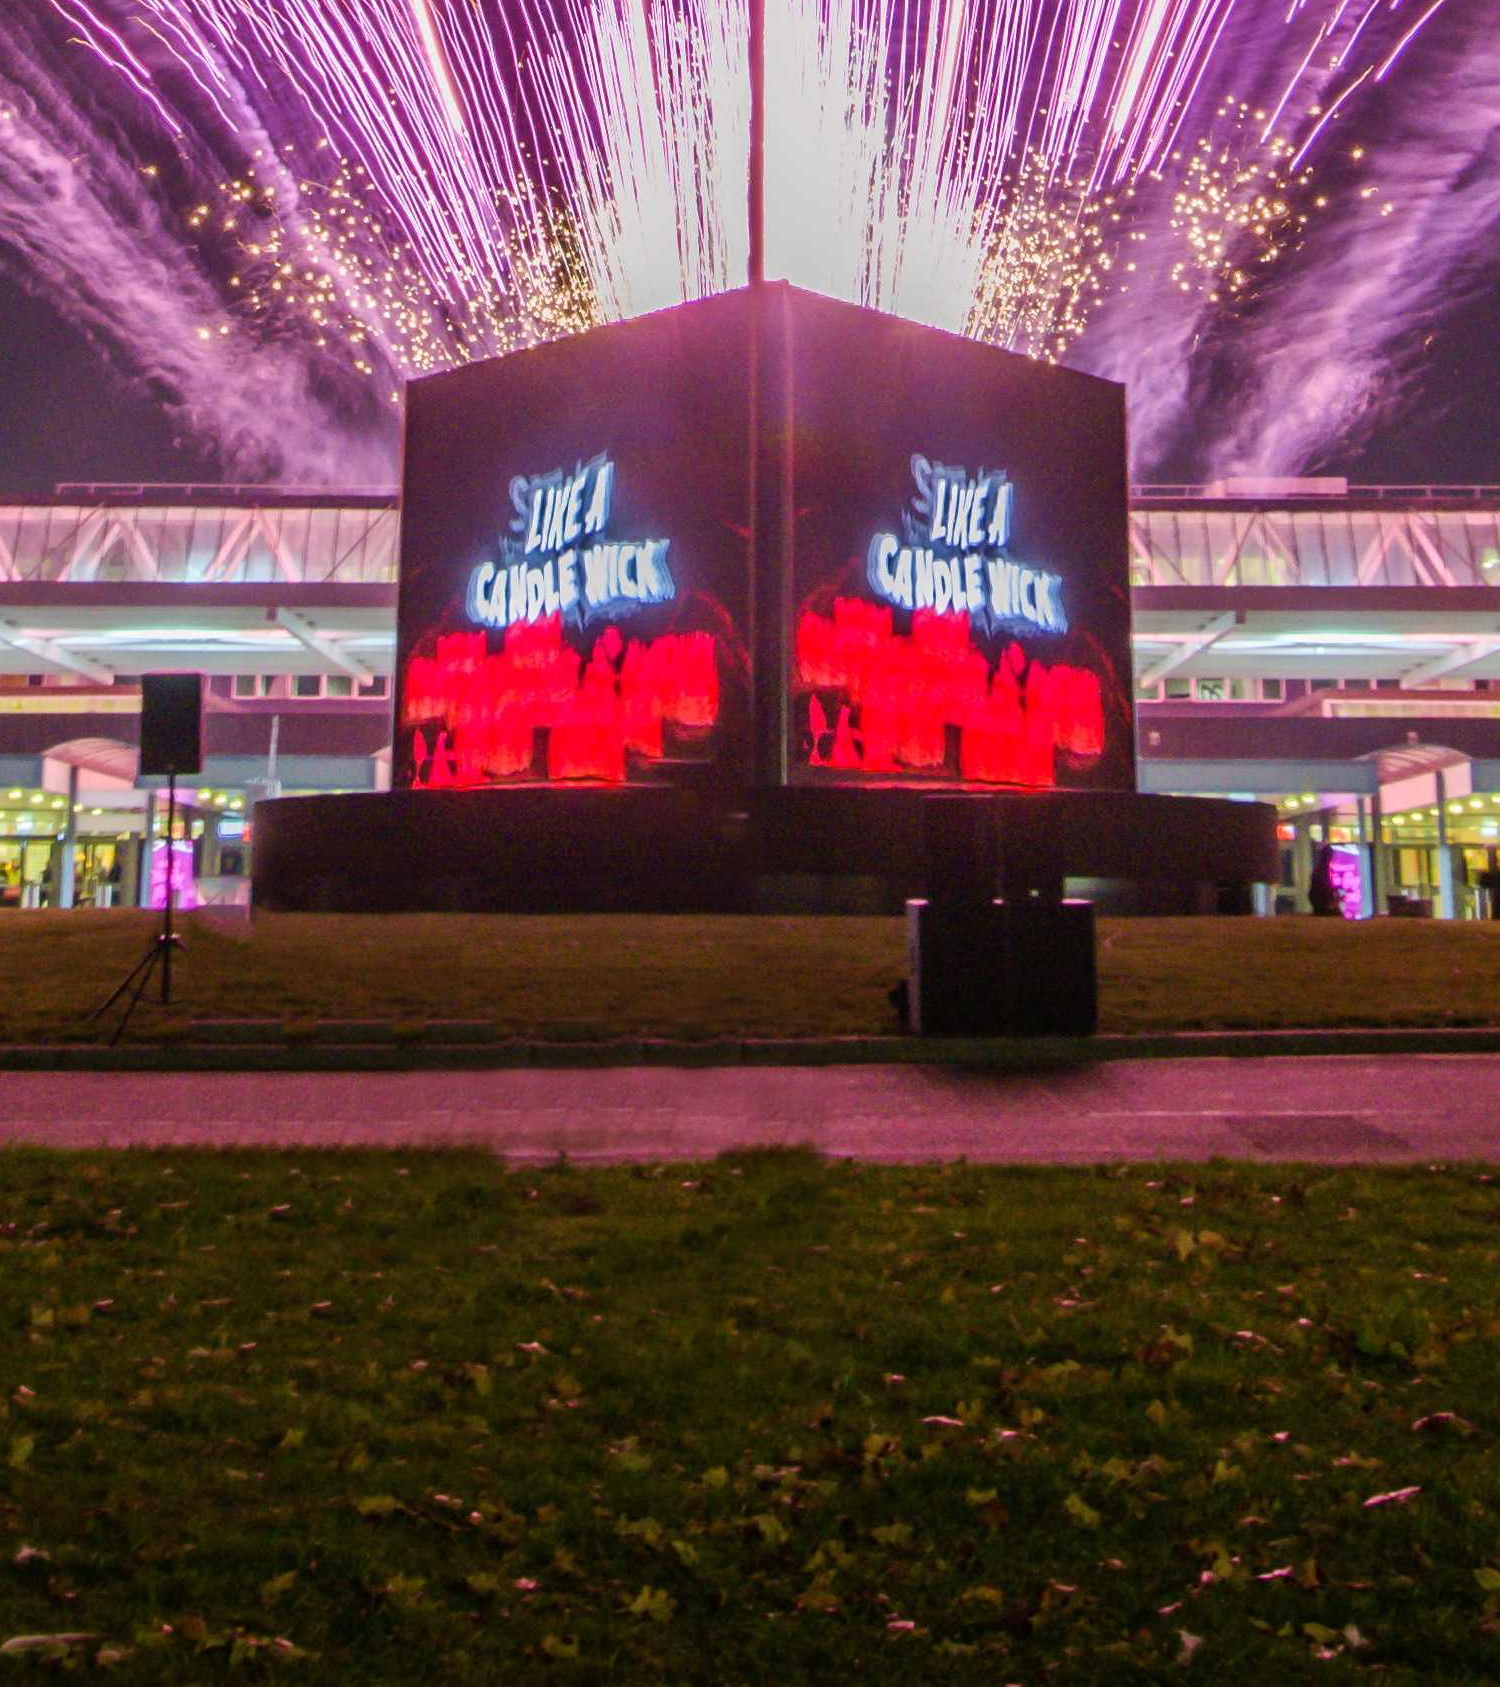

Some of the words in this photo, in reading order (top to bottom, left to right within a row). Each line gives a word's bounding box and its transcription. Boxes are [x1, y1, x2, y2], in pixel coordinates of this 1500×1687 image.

[525, 473, 587, 555] LIKE
[584, 462, 614, 535] A
[930, 478, 989, 551] LIKE
[987, 482, 1013, 548] A
[470, 549, 580, 629] CANDLE
[583, 539, 669, 610] WICK
[871, 533, 987, 615] CANDLE
[988, 558, 1064, 633] WICK
